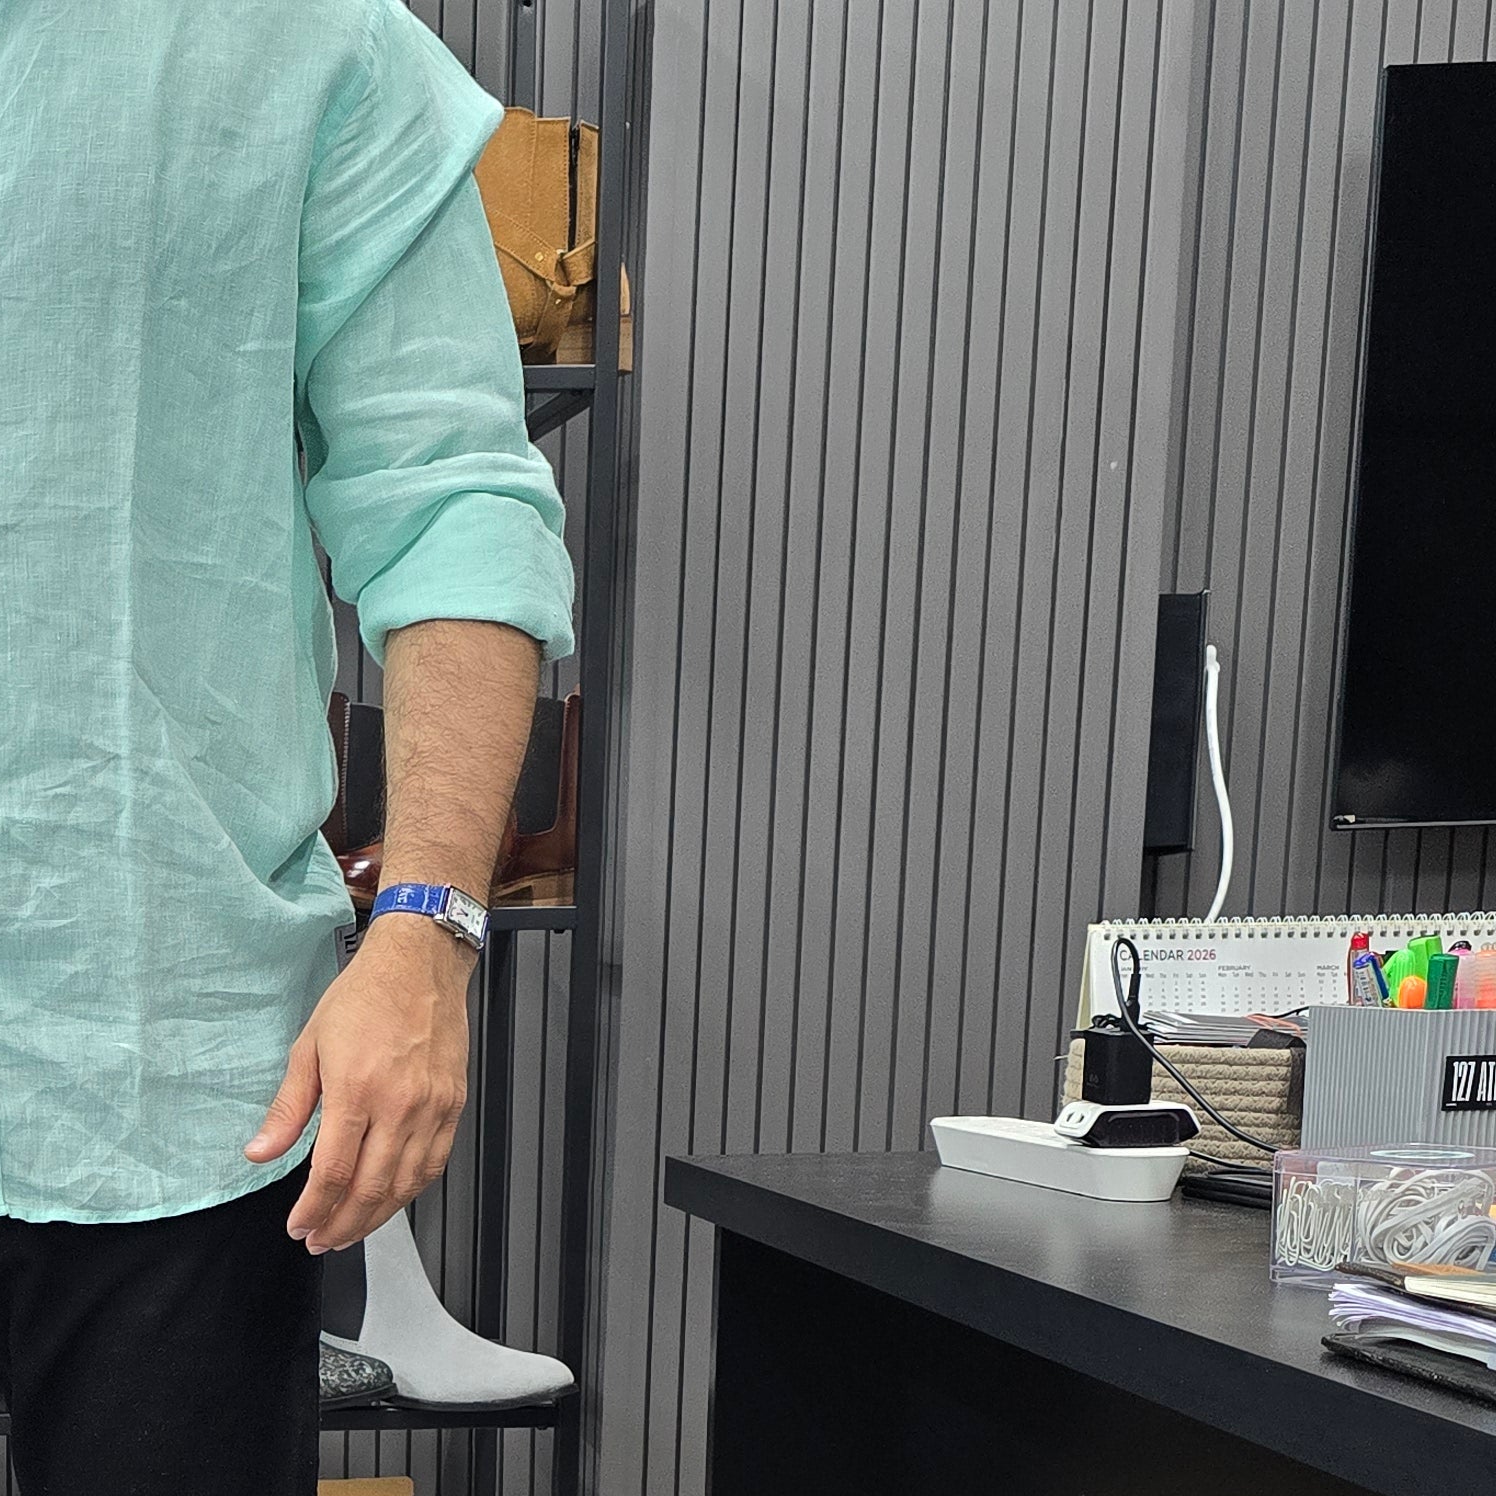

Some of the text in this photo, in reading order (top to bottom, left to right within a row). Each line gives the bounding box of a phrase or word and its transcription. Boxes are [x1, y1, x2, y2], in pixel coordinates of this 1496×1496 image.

[1120, 949, 1216, 961] CENDAR 2026
[1451, 1061, 1496, 1102] 127 AT
